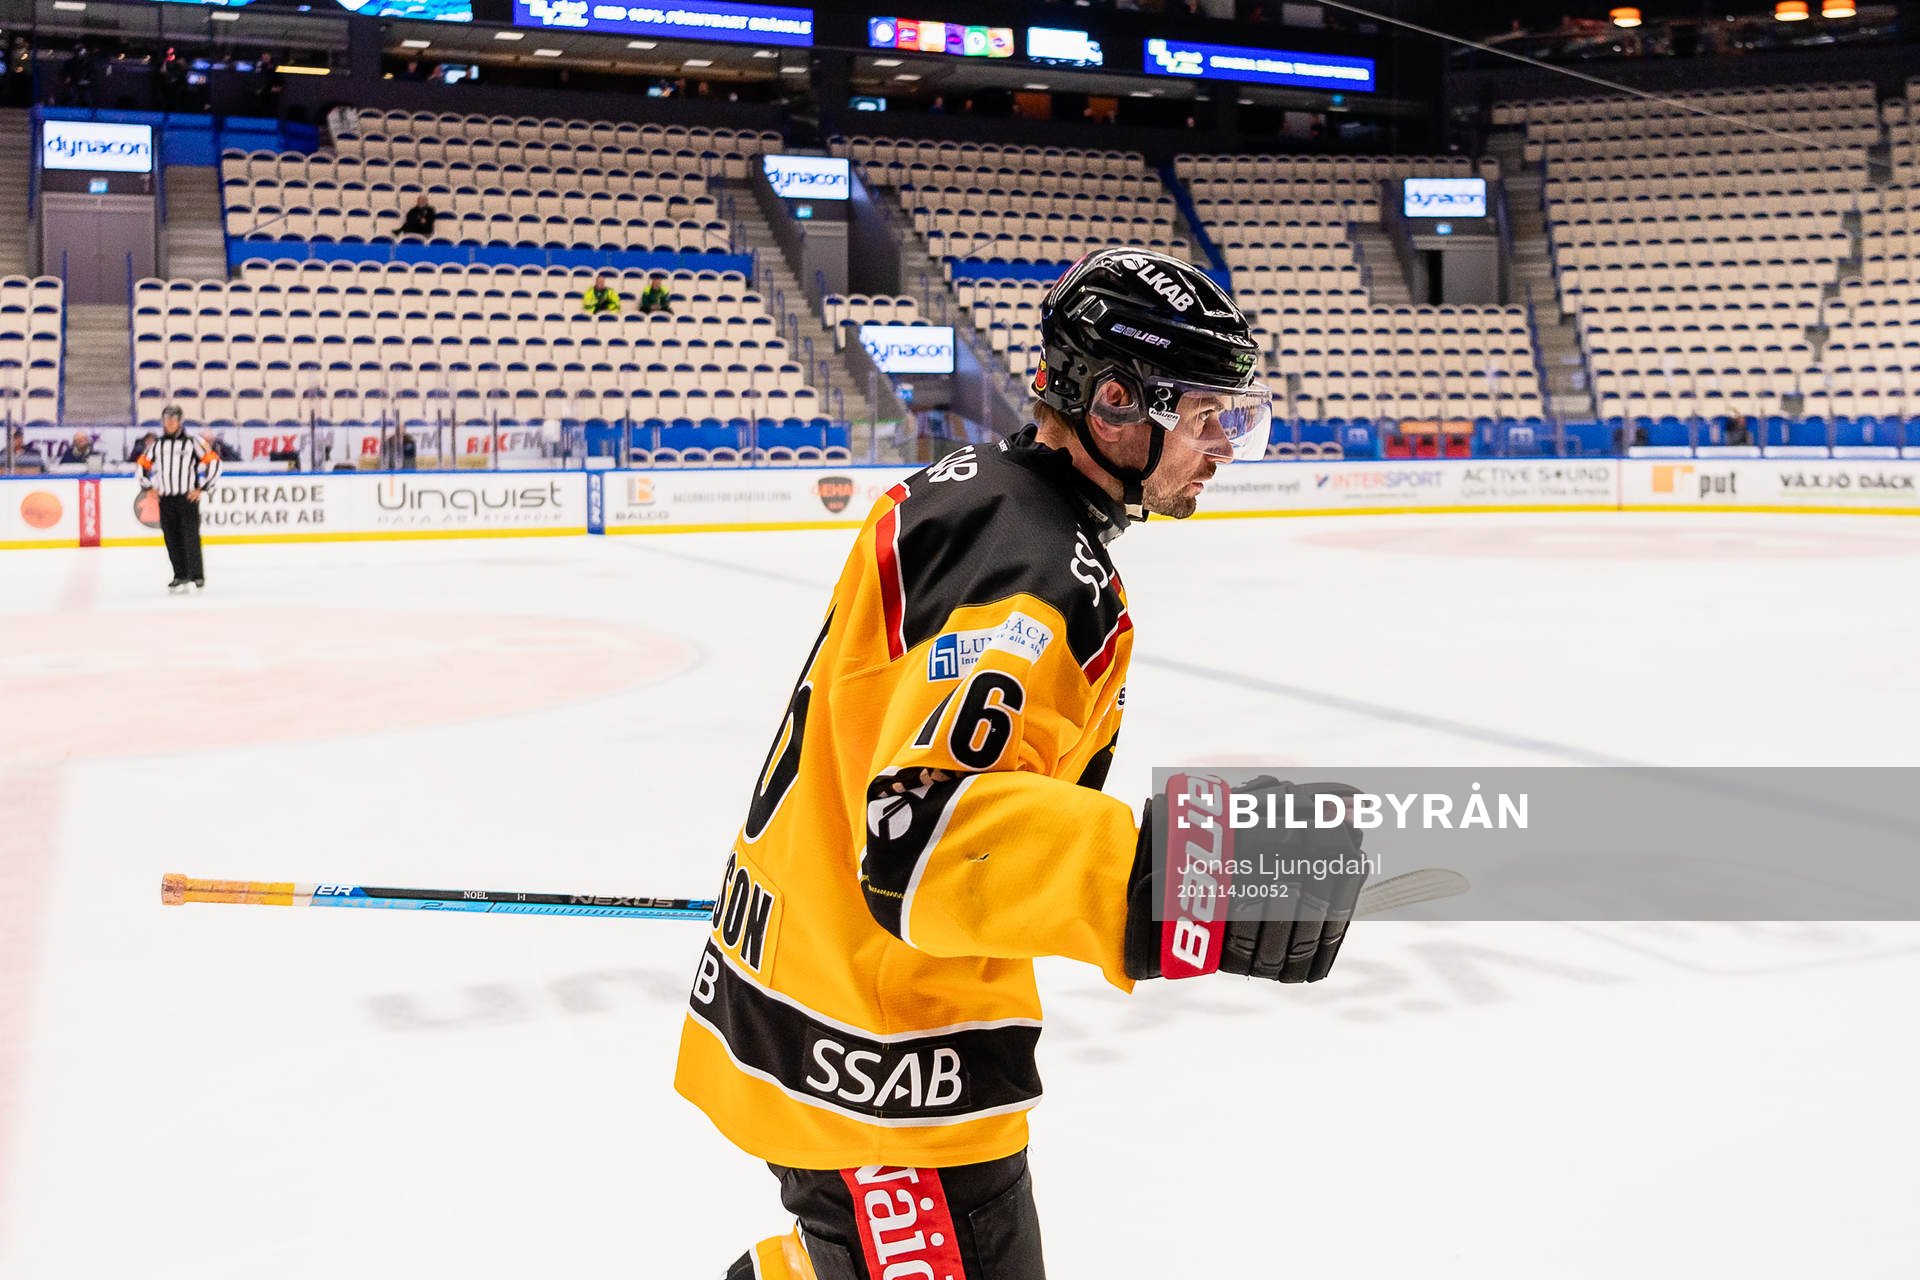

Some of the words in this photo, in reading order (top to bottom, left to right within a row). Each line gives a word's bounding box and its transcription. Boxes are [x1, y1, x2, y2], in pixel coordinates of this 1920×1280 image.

[47, 135, 151, 157] dynacon
[767, 168, 847, 188] dynacon
[1137, 262, 1194, 312] LKAB
[1110, 323, 1172, 350] BAUER
[864, 341, 952, 362] dynacon
[1462, 467, 1531, 480] ACTIVE
[205, 485, 325, 504] YDTRADE
[1700, 472, 1736, 499] put
[200, 511, 289, 525] RUCKAR
[297, 509, 325, 524] AB
[463, 891, 488, 899] NOEL
[570, 896, 675, 908] NEXUS
[806, 1039, 963, 1108] SSAB
